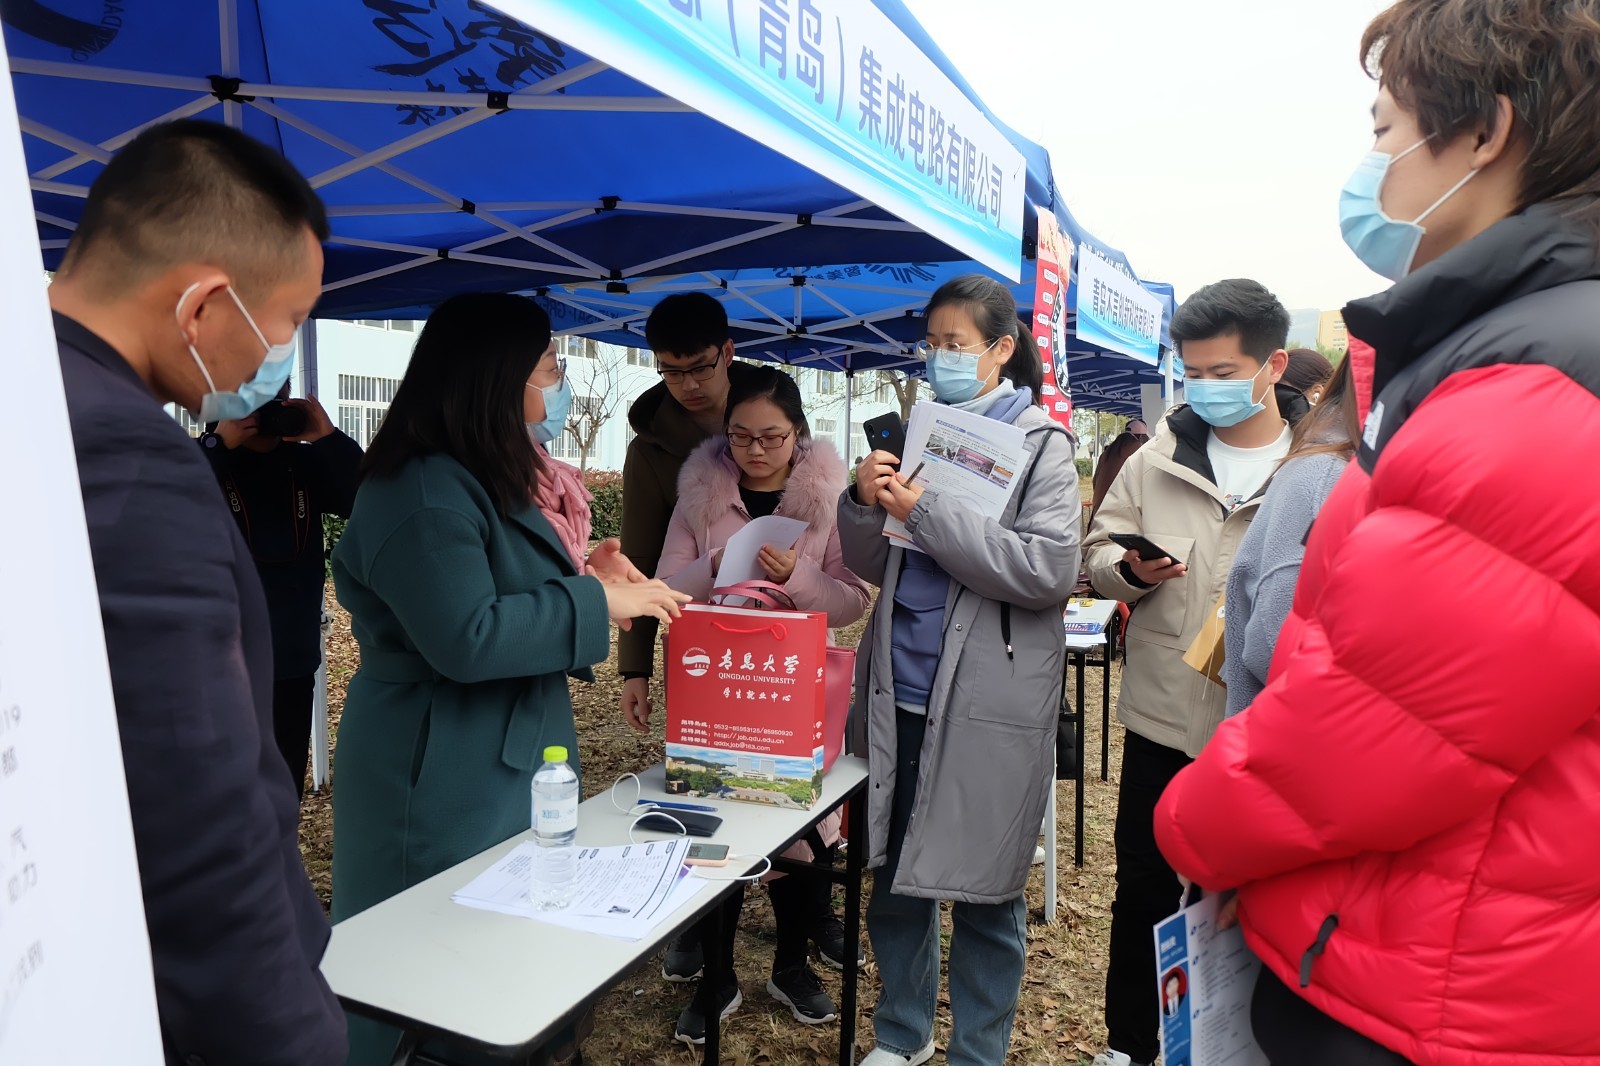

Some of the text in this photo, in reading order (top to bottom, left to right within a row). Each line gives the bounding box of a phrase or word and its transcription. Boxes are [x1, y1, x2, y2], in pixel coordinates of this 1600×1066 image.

[669, 0, 1004, 229] （青岛）集成电路有限公司
[229, 492, 241, 512] EOS
[297, 490, 306, 519] Canon
[718, 648, 800, 675] 青岛大学
[718, 672, 796, 685] QINGDAO UNIVERSITY
[722, 687, 792, 703] 学生就业中心
